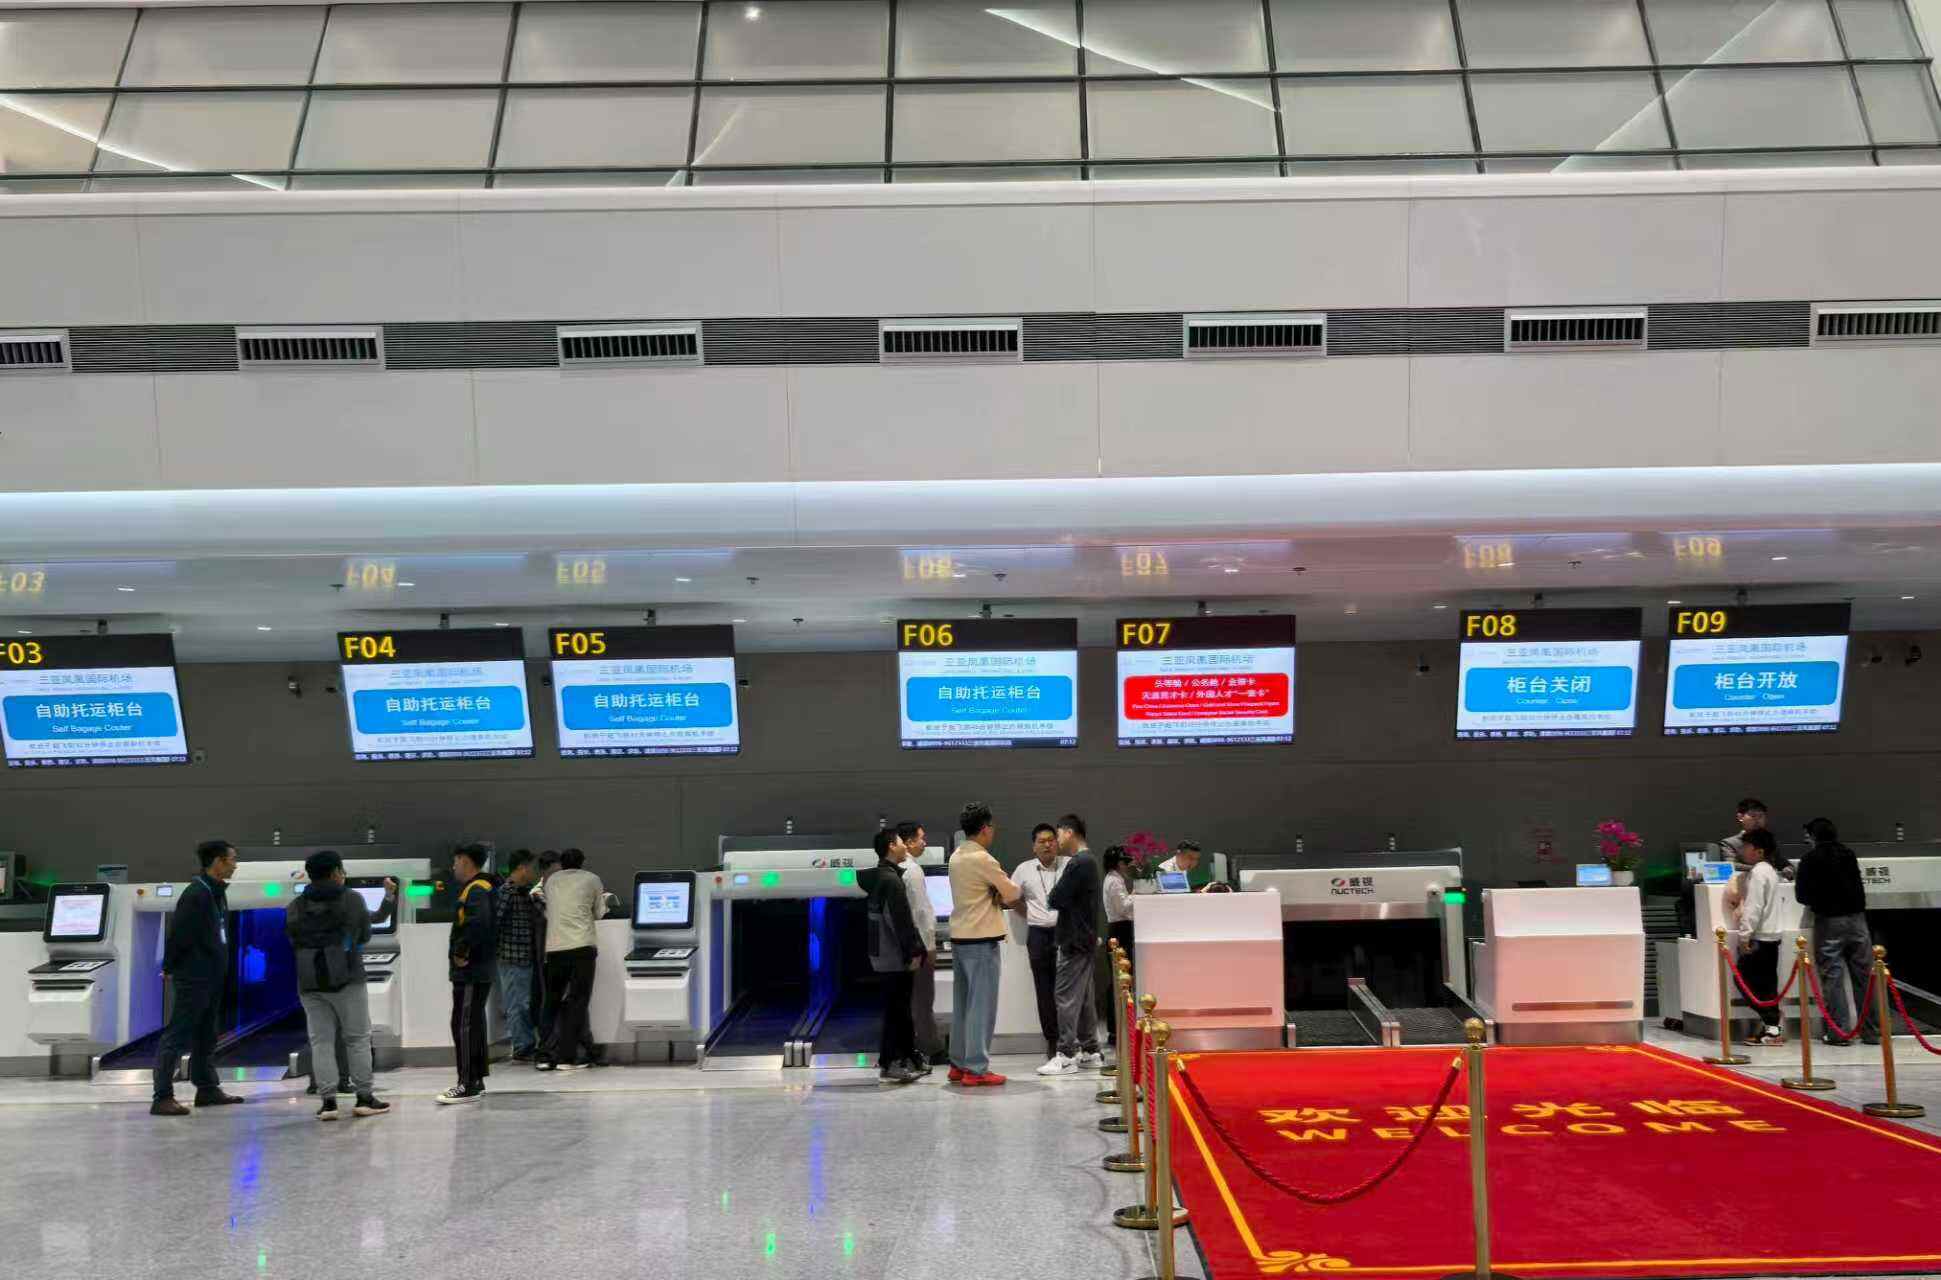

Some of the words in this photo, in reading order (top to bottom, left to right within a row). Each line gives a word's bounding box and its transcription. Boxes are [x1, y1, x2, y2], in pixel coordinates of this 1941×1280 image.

[1466, 614, 1517, 637] F08
[1677, 610, 1727, 633] F09
[555, 632, 607, 655] F05
[903, 624, 953, 646] F06
[1122, 622, 1171, 645] F07
[344, 636, 396, 659] F04
[1506, 675, 1592, 694] 柜台关闭
[1714, 671, 1799, 690] 柜台开放
[386, 695, 491, 712] 自助托运柜台
[594, 692, 700, 709] 自助托运柜台
[938, 685, 1041, 700] 自助托运柜台
[36, 702, 143, 719] 自助托运柜台
[1258, 1099, 1745, 1124] 欢迎光临
[1277, 1119, 1787, 1142] WELCOME
